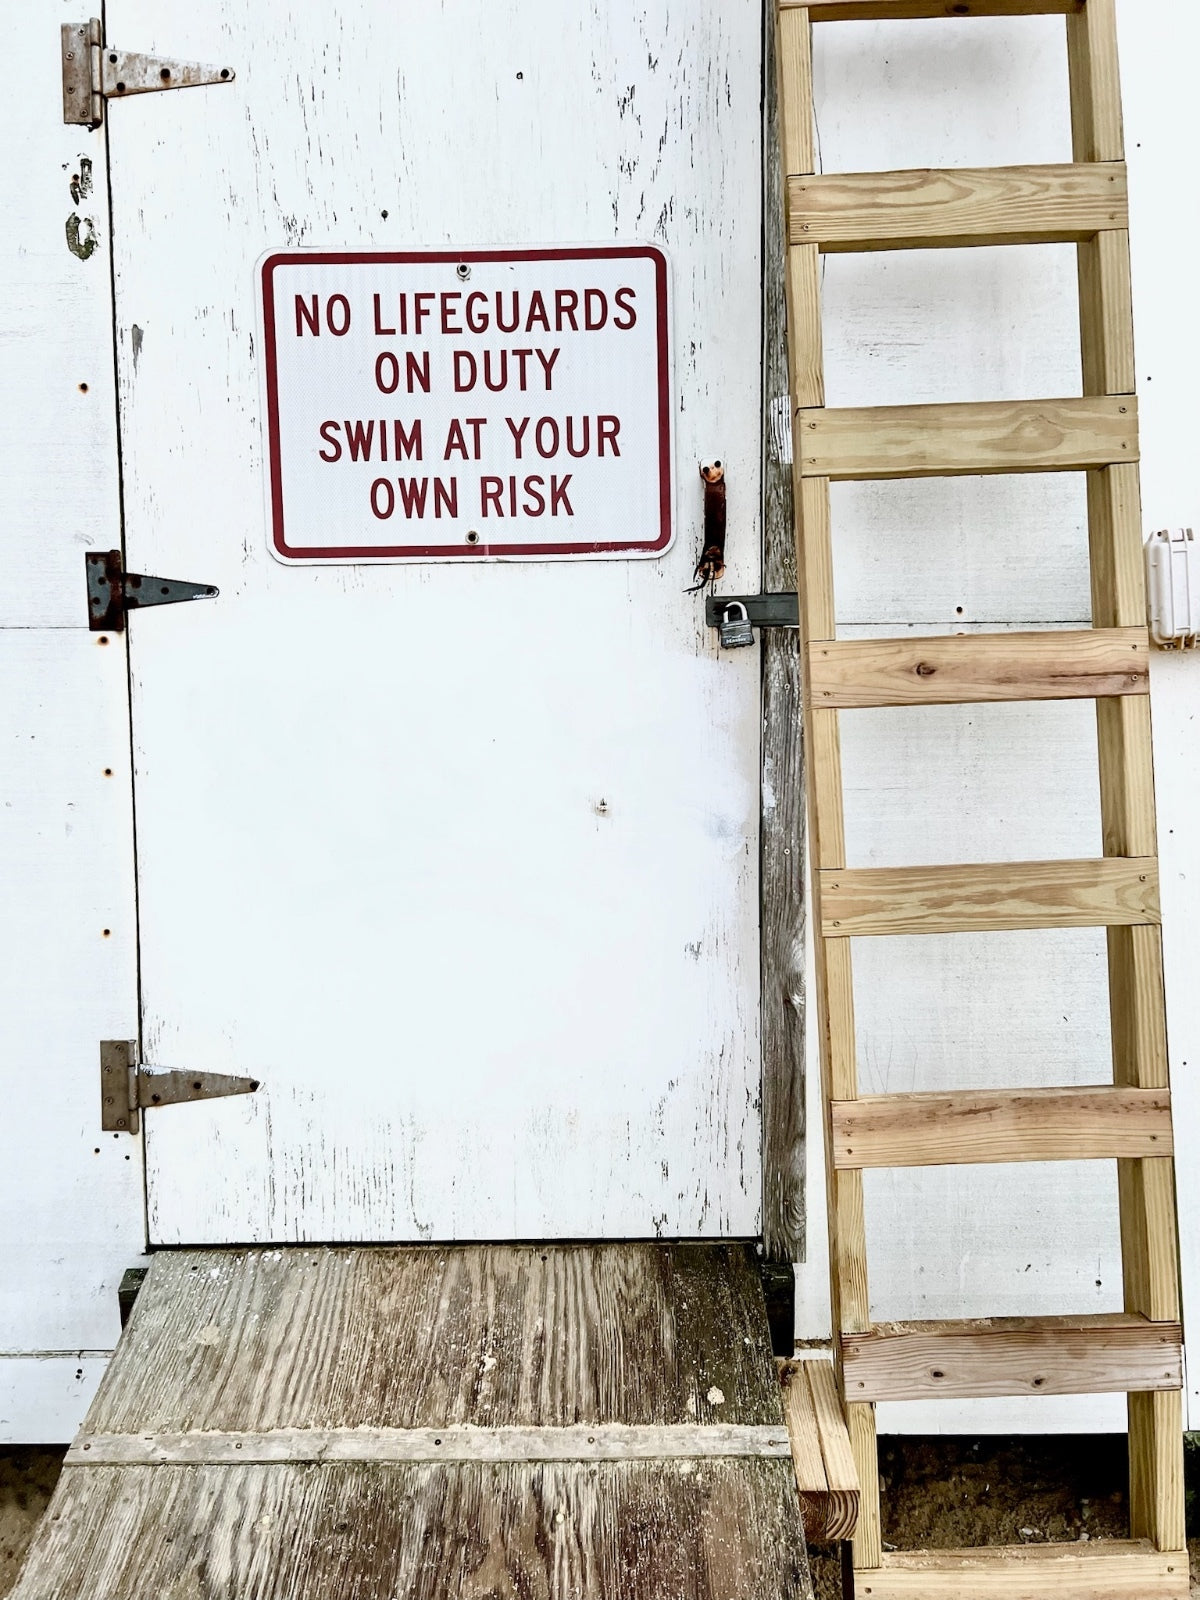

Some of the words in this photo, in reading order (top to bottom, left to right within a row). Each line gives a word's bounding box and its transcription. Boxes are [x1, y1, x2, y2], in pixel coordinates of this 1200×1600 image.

[295, 293, 351, 336] NO
[373, 287, 637, 335] LIFEGUARDS
[375, 351, 431, 394] ON
[453, 348, 560, 393] DUTY
[318, 419, 423, 463] SWIM
[443, 417, 487, 461] AT
[504, 415, 621, 459] YOUR
[370, 476, 458, 520] OWN
[480, 474, 574, 518] RISK
